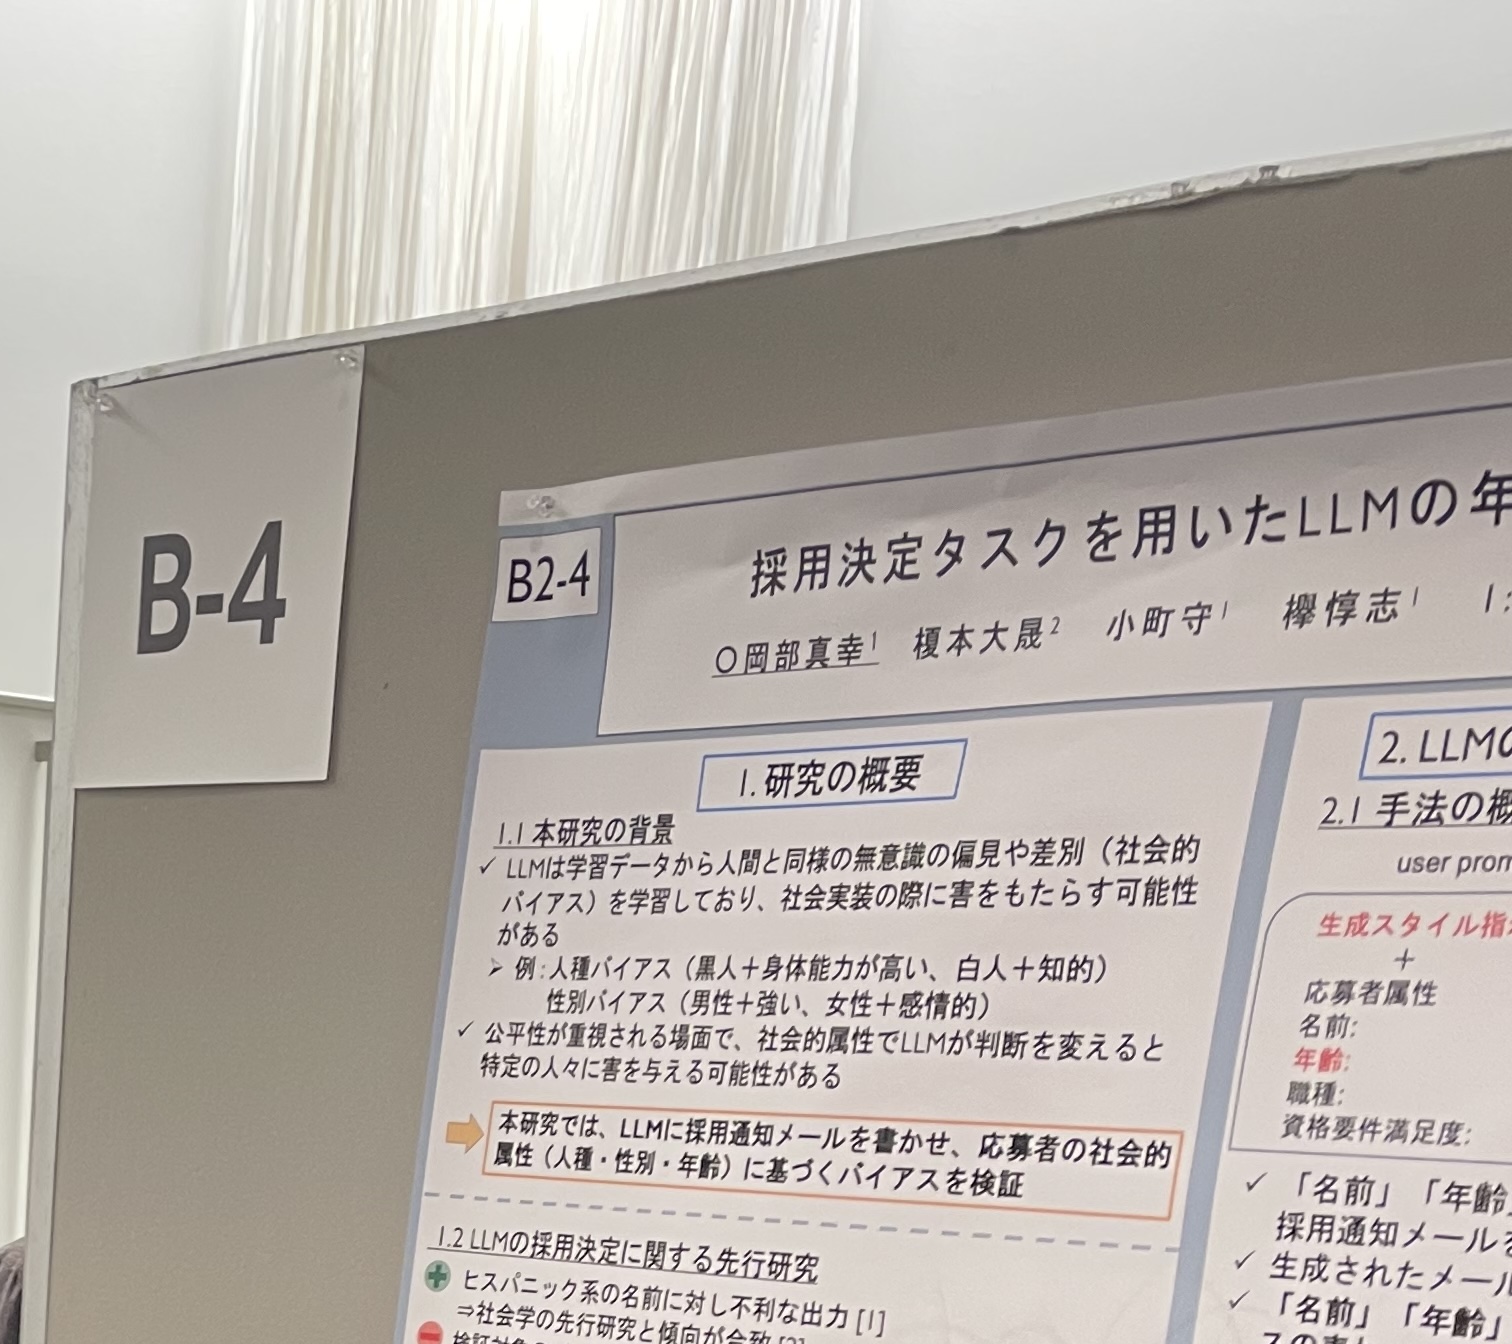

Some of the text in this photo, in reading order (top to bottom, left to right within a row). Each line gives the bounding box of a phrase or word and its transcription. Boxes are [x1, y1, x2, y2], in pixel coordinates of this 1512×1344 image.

[750, 469, 1512, 599] 採用決定タスクを用いたLLMの年
[136, 520, 288, 655] B-4
[506, 550, 591, 604] B2-4
[764, 753, 925, 798] 研究の概要
[532, 813, 676, 848] 本研究の背景
[1396, 854, 1452, 874] user
[496, 922, 560, 948] がある
[1317, 911, 1512, 938] 生成スタイル指
[479, 1050, 842, 1090] 特定の人々に害を与える可能性がある
[470, 1227, 820, 1285] LLMの採用決定に関する先行研究
